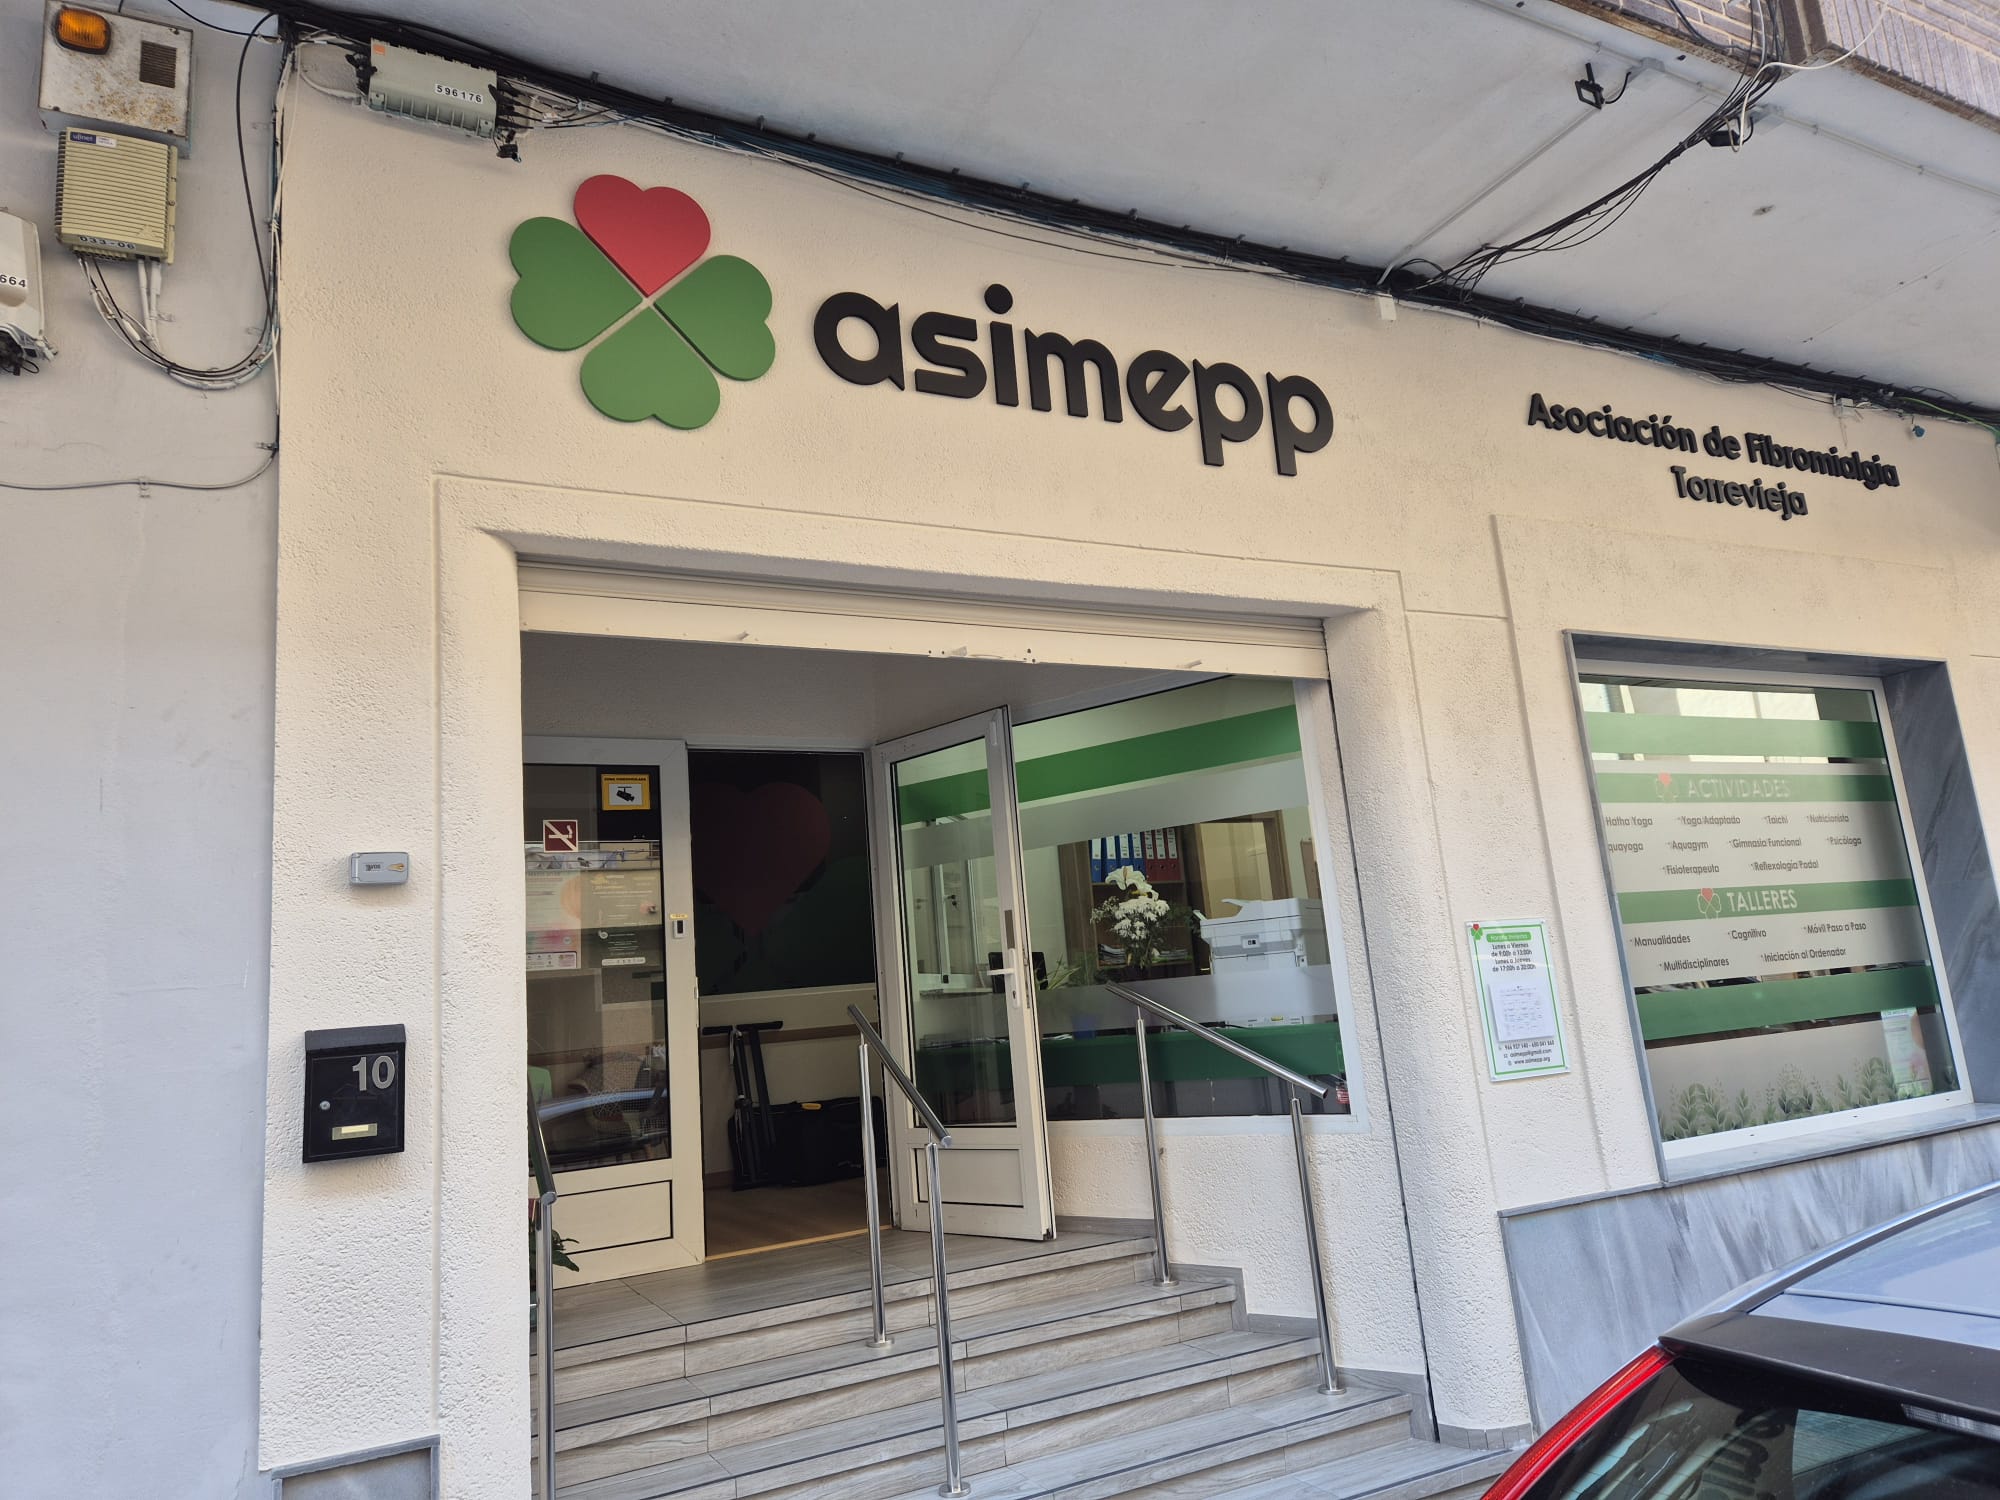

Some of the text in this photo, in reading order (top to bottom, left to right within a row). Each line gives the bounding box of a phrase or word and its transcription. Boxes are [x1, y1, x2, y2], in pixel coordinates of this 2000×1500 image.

[436, 84, 482, 103] 596176
[79, 235, 135, 249] 033-06
[814, 283, 1335, 477] asimepp
[1527, 392, 1901, 490] Asociación de Fibromialgia
[1671, 465, 1809, 521] Torrevieja
[1688, 778, 1790, 798] ACTIVIDADES
[1632, 816, 1654, 828] Yoga
[1681, 816, 1702, 827] Yoga
[1704, 815, 1741, 827] Adaptado
[1607, 842, 1644, 853] quayoga
[1672, 840, 1709, 851] Aquagym
[1732, 838, 1767, 849] Gimnasia
[1768, 837, 1802, 847] Funcional
[1666, 864, 1720, 875] Fisioterapeuta
[1799, 859, 1819, 869] Podal
[1726, 889, 1798, 912] TALLERES
[1634, 934, 1691, 947] Manualidades
[1731, 928, 1767, 941] Cognitivo
[1826, 923, 1843, 932] Paso
[1850, 922, 1867, 931] Paso
[1664, 957, 1730, 972] Multidisciplinares
[1801, 950, 1809, 960] al
[1809, 948, 1847, 959] Ordenador
[352, 1055, 396, 1092] 10
